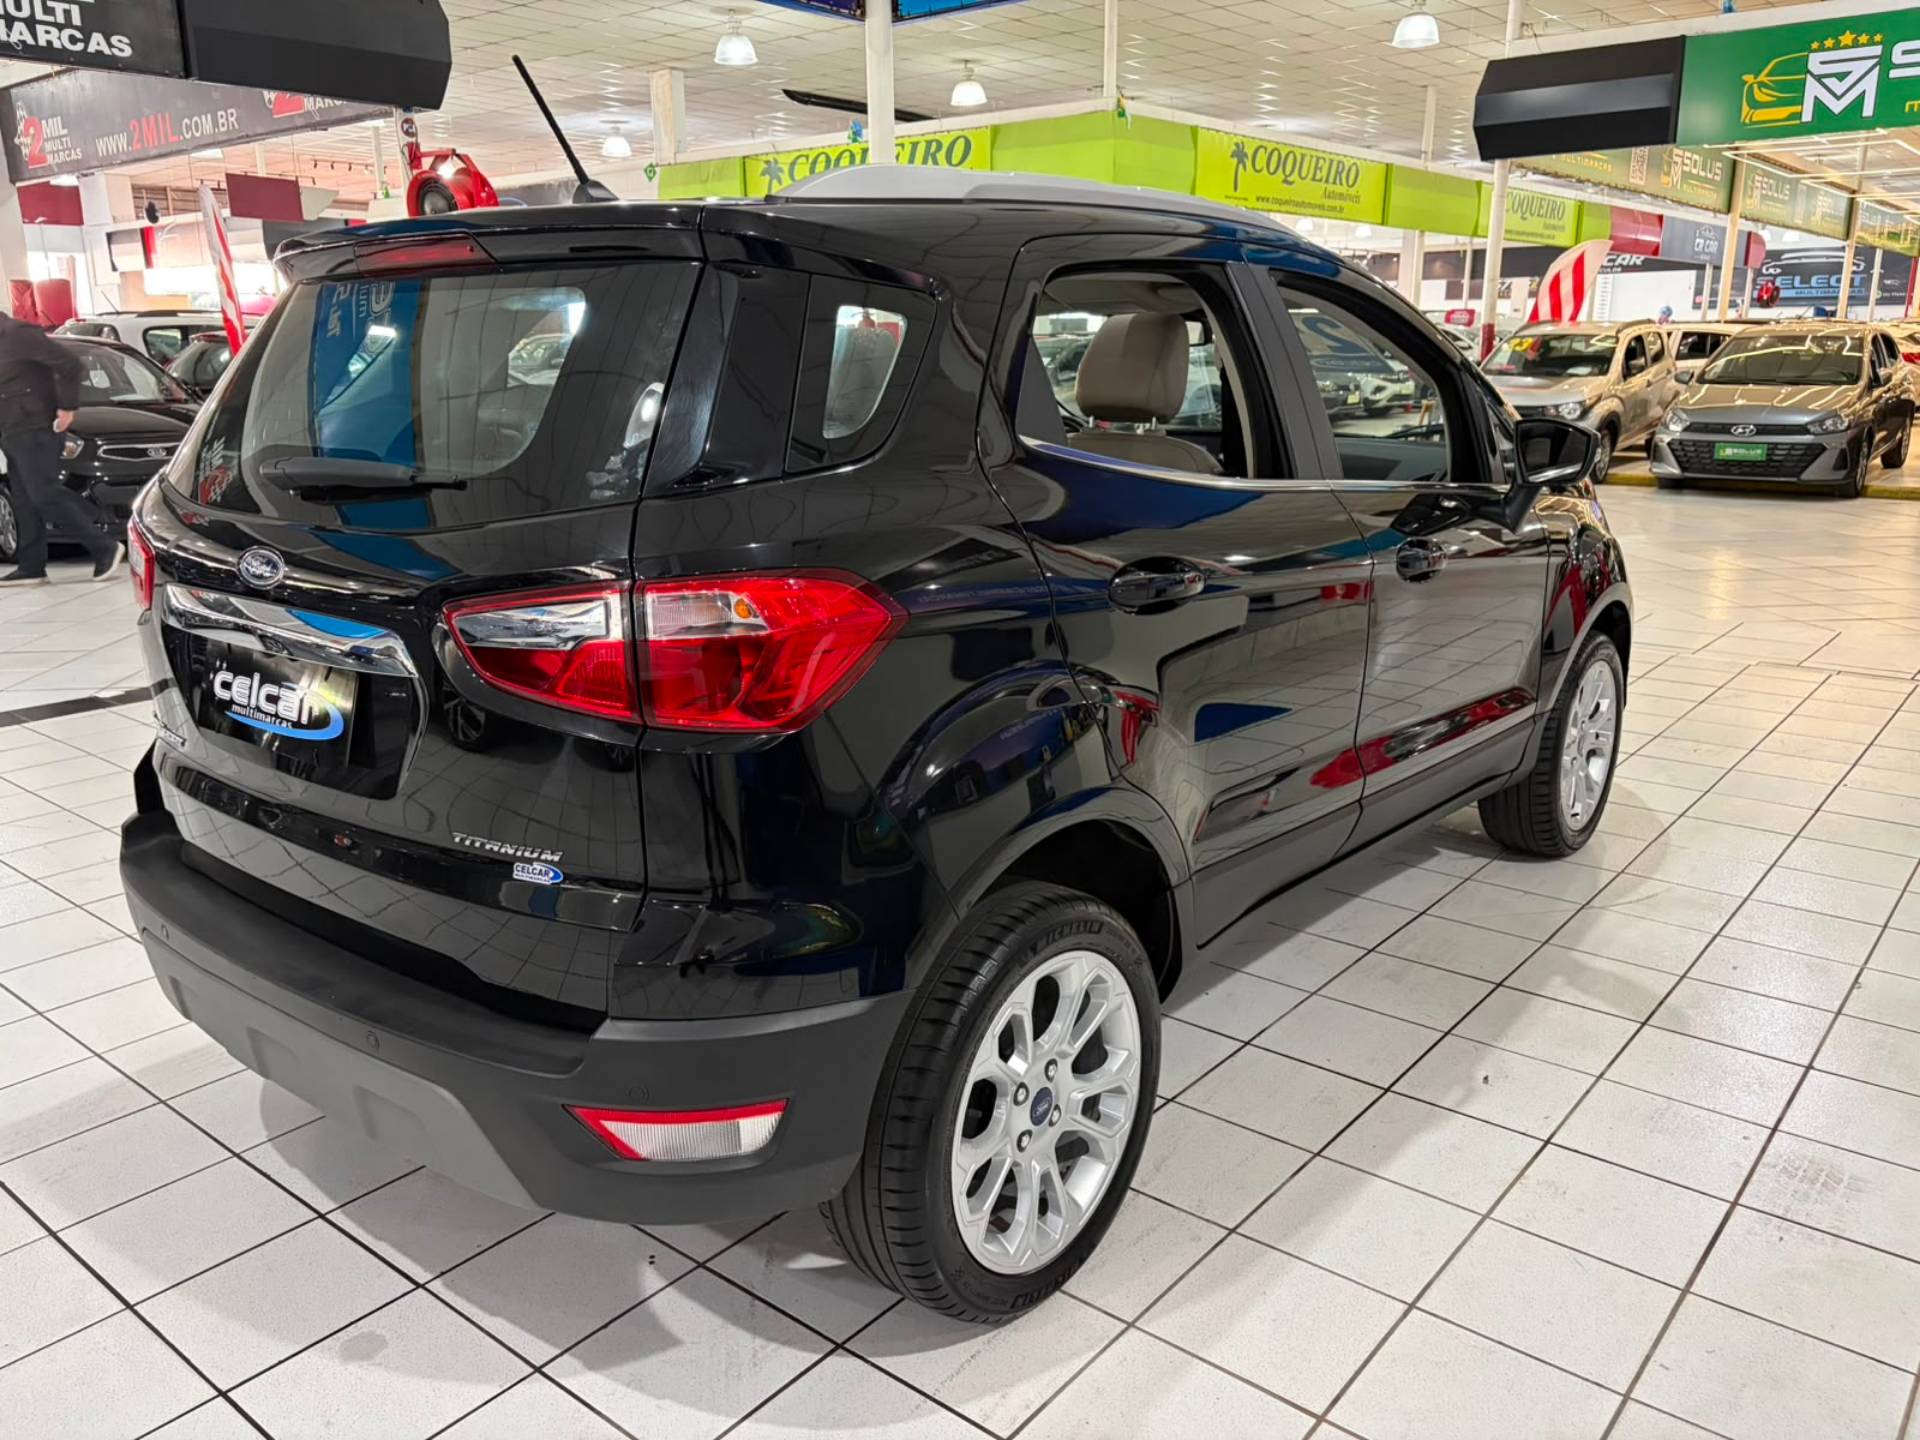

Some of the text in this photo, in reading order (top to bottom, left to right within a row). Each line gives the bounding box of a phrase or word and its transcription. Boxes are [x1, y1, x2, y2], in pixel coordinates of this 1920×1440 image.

[0, 0, 82, 26] ULTI
[42, 116, 68, 138] MIL
[44, 136, 72, 152] MULTI
[46, 148, 82, 166] MARCAS
[1251, 144, 1360, 189] COQUEIRO
[1682, 151, 1723, 181] SOLUS
[213, 670, 320, 725] celcar
[231, 704, 293, 730] multimarcas
[452, 832, 563, 862] TITANIUM
[514, 864, 552, 879] CELCAR
